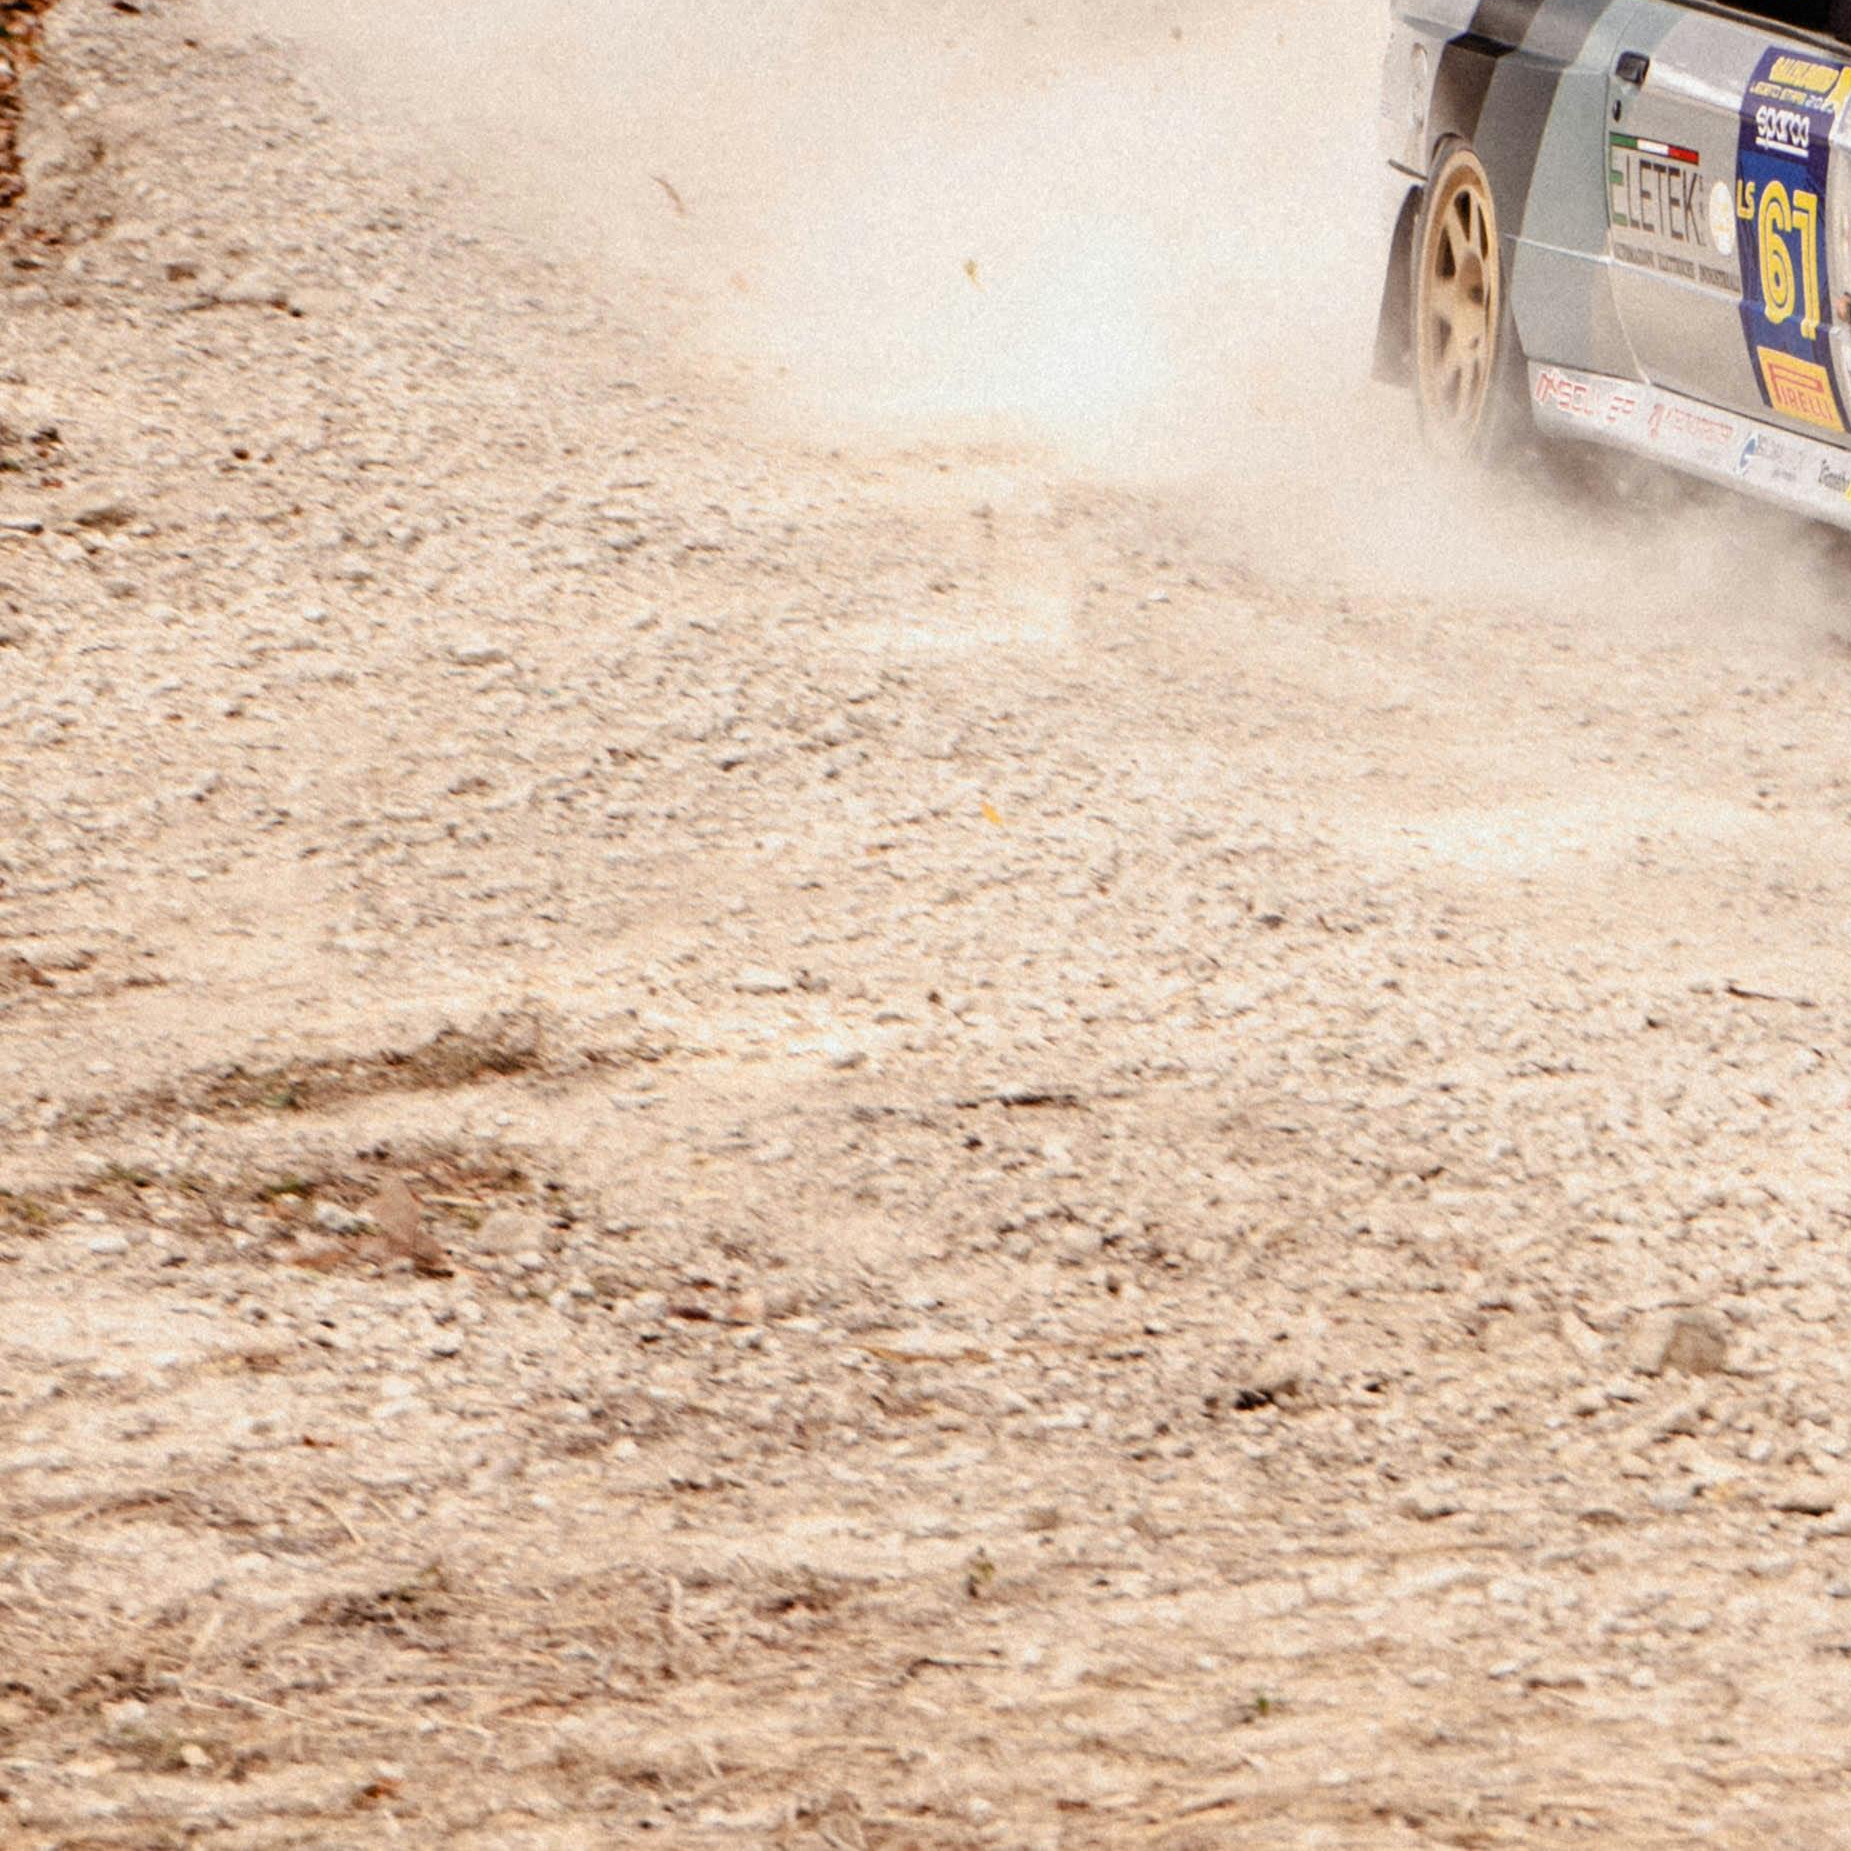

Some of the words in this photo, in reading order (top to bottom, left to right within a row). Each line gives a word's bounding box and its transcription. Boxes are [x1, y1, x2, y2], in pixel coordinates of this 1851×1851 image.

[1755, 104, 1810, 150] sparco
[1609, 137, 1705, 247] ELETEK
[1736, 178, 1756, 221] LS
[1758, 179, 1821, 341] 67
[1767, 361, 1835, 422] PIRELLI
